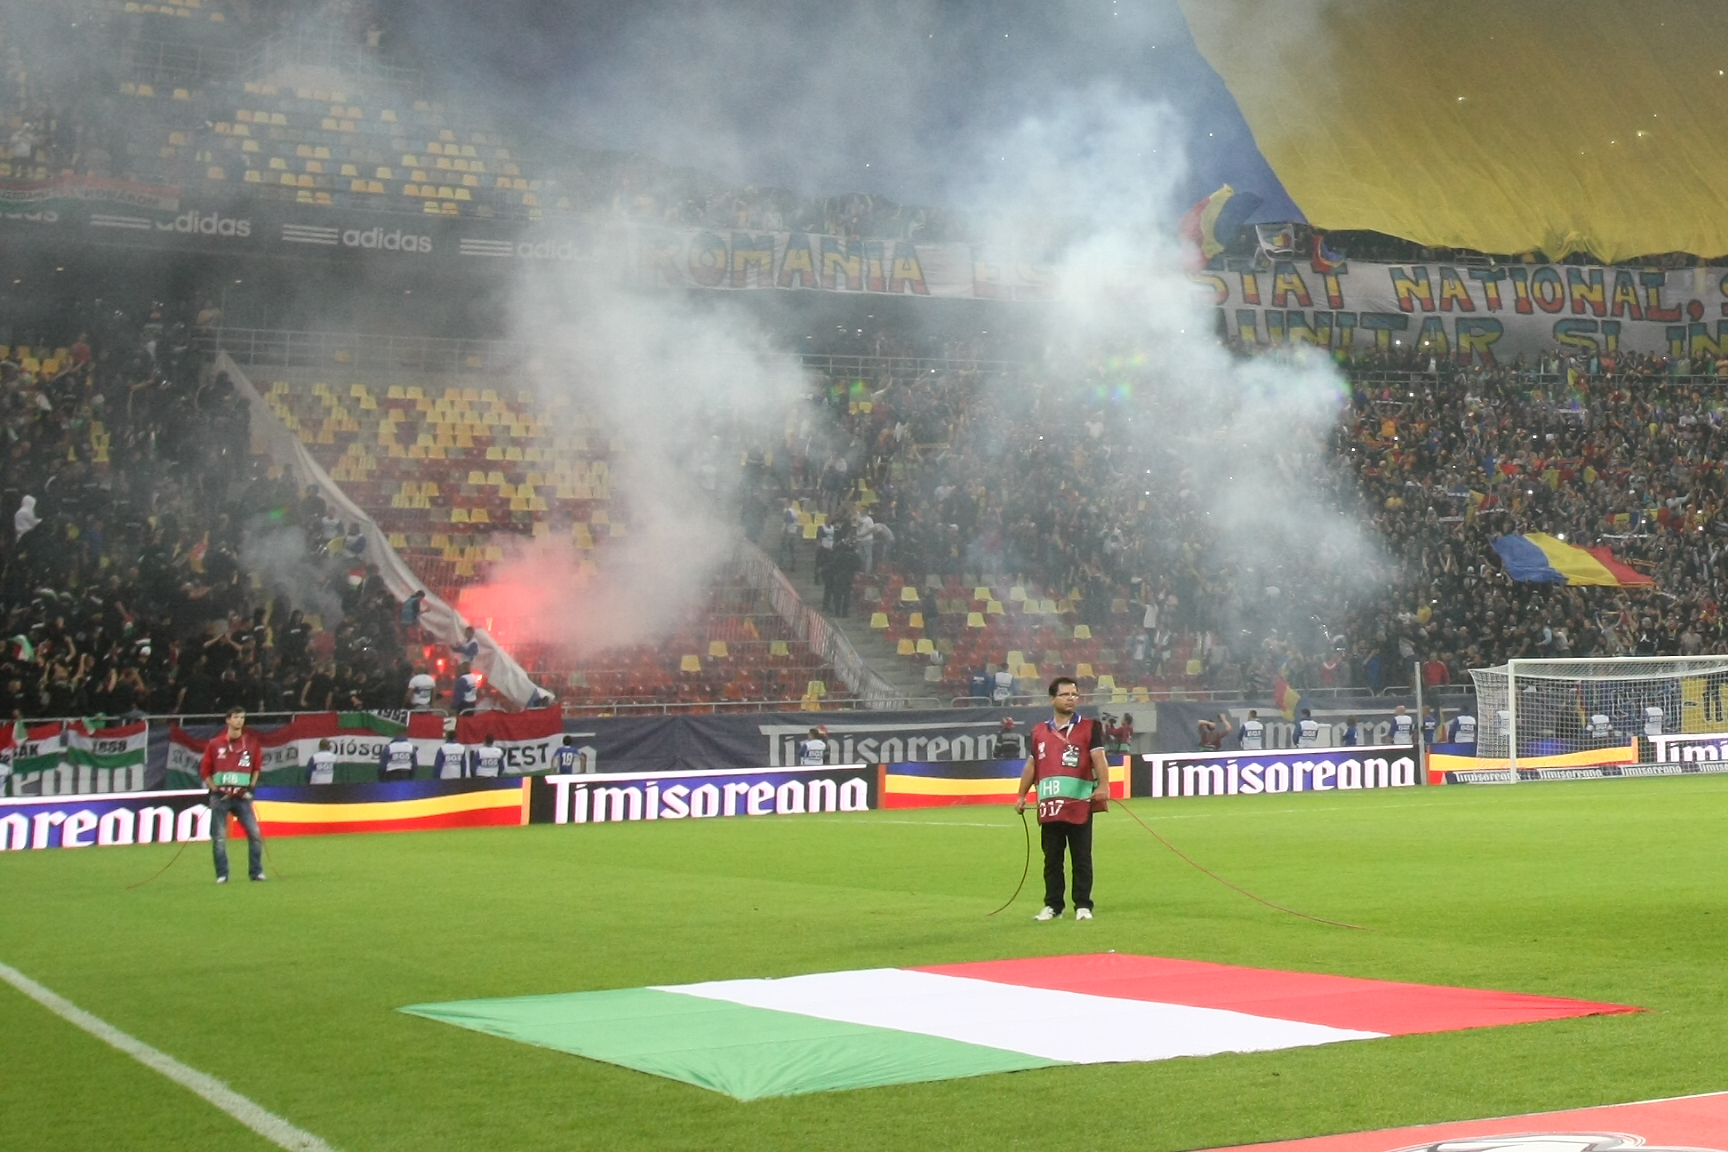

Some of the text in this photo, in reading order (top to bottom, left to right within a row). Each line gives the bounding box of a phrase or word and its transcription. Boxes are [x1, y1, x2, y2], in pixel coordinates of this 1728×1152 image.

[343, 226, 433, 254] adidas
[1043, 780, 1060, 795] HB
[1142, 744, 1416, 798] Timisoreana
[545, 763, 869, 825] Timisoreana
